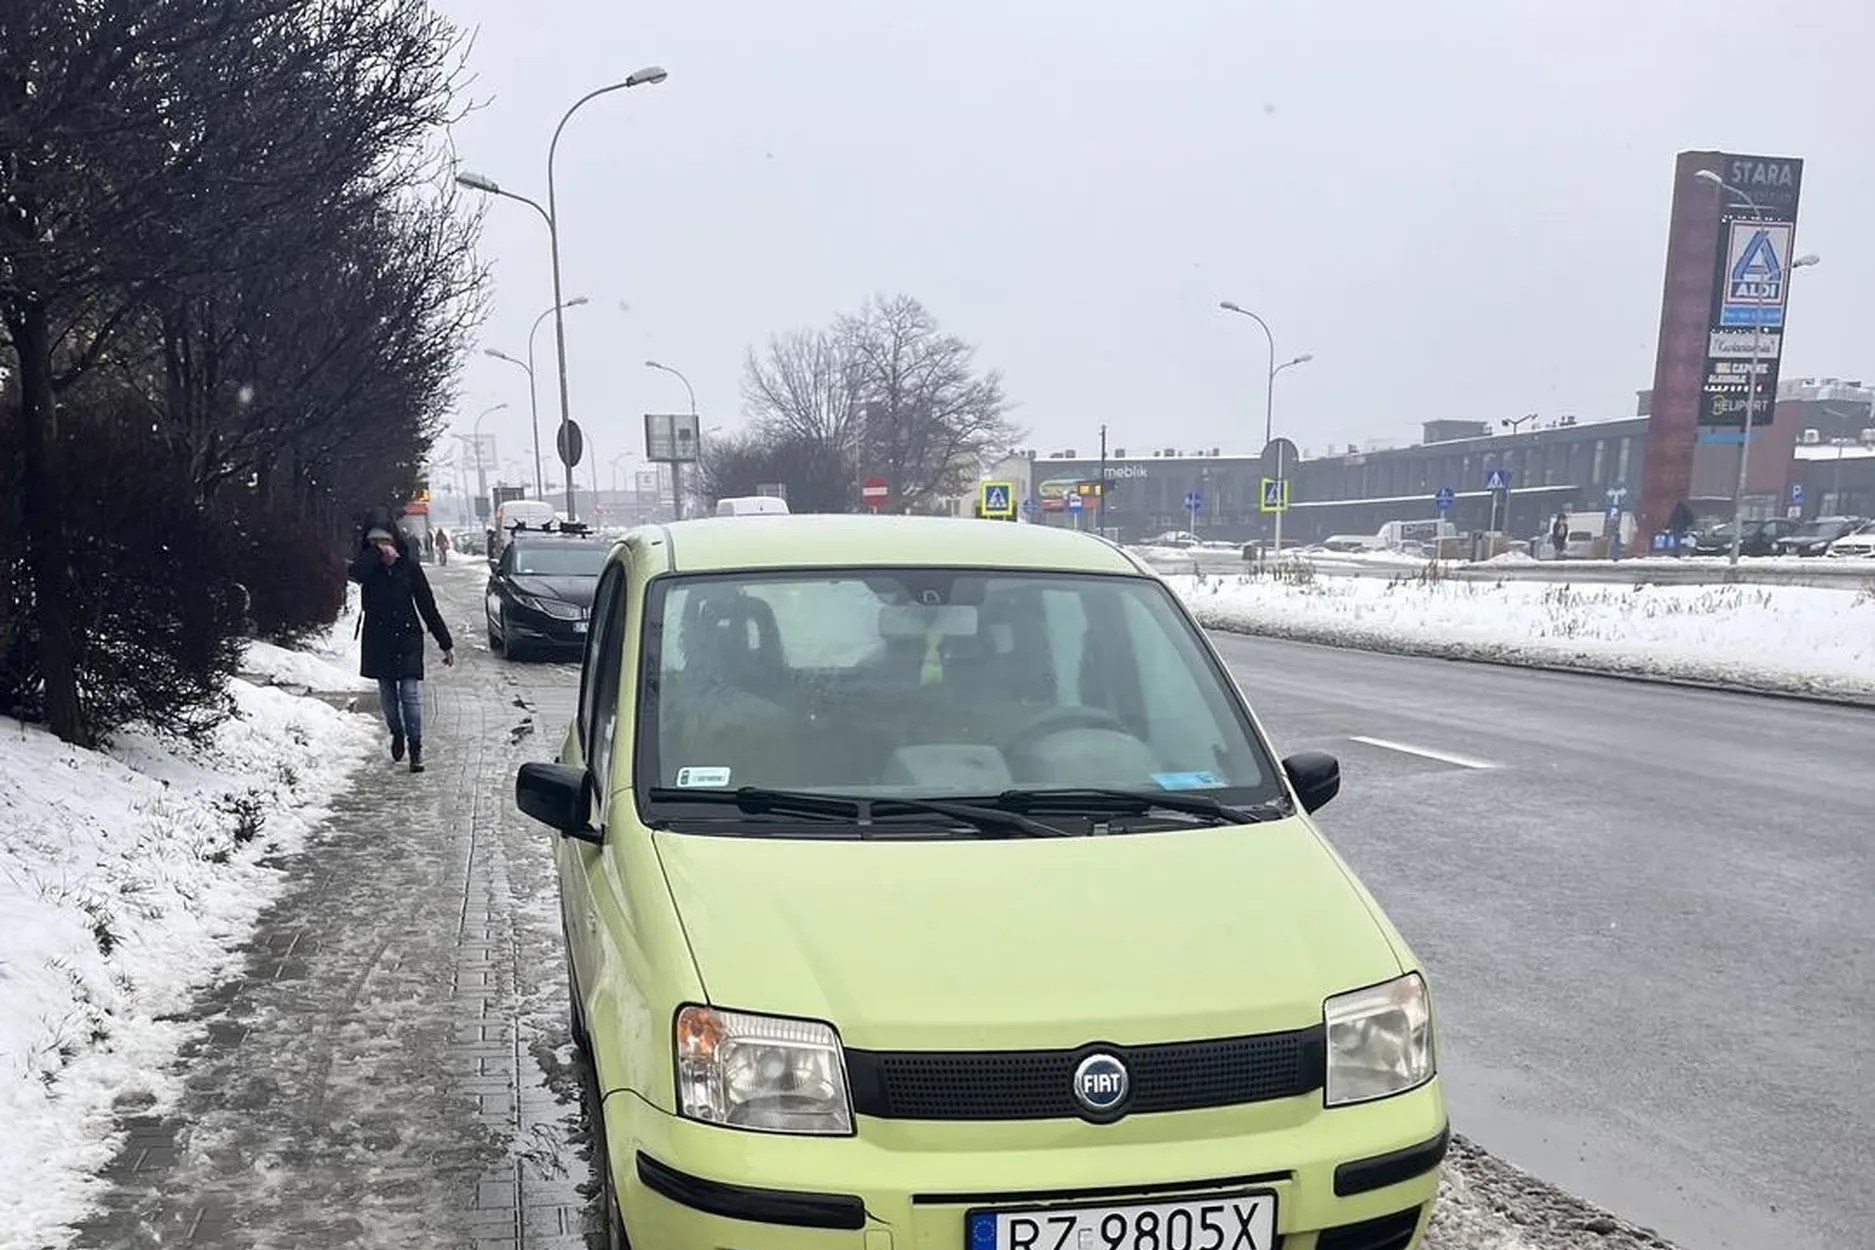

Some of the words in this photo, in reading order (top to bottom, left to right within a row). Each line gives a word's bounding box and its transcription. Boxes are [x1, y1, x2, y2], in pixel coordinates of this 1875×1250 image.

[1732, 161, 1792, 186] STARA
[1735, 283, 1777, 297] ALDI
[1713, 400, 1768, 412] HELIPRT
[1104, 465, 1148, 478] meblik
[1083, 1073, 1120, 1093] FIAT
